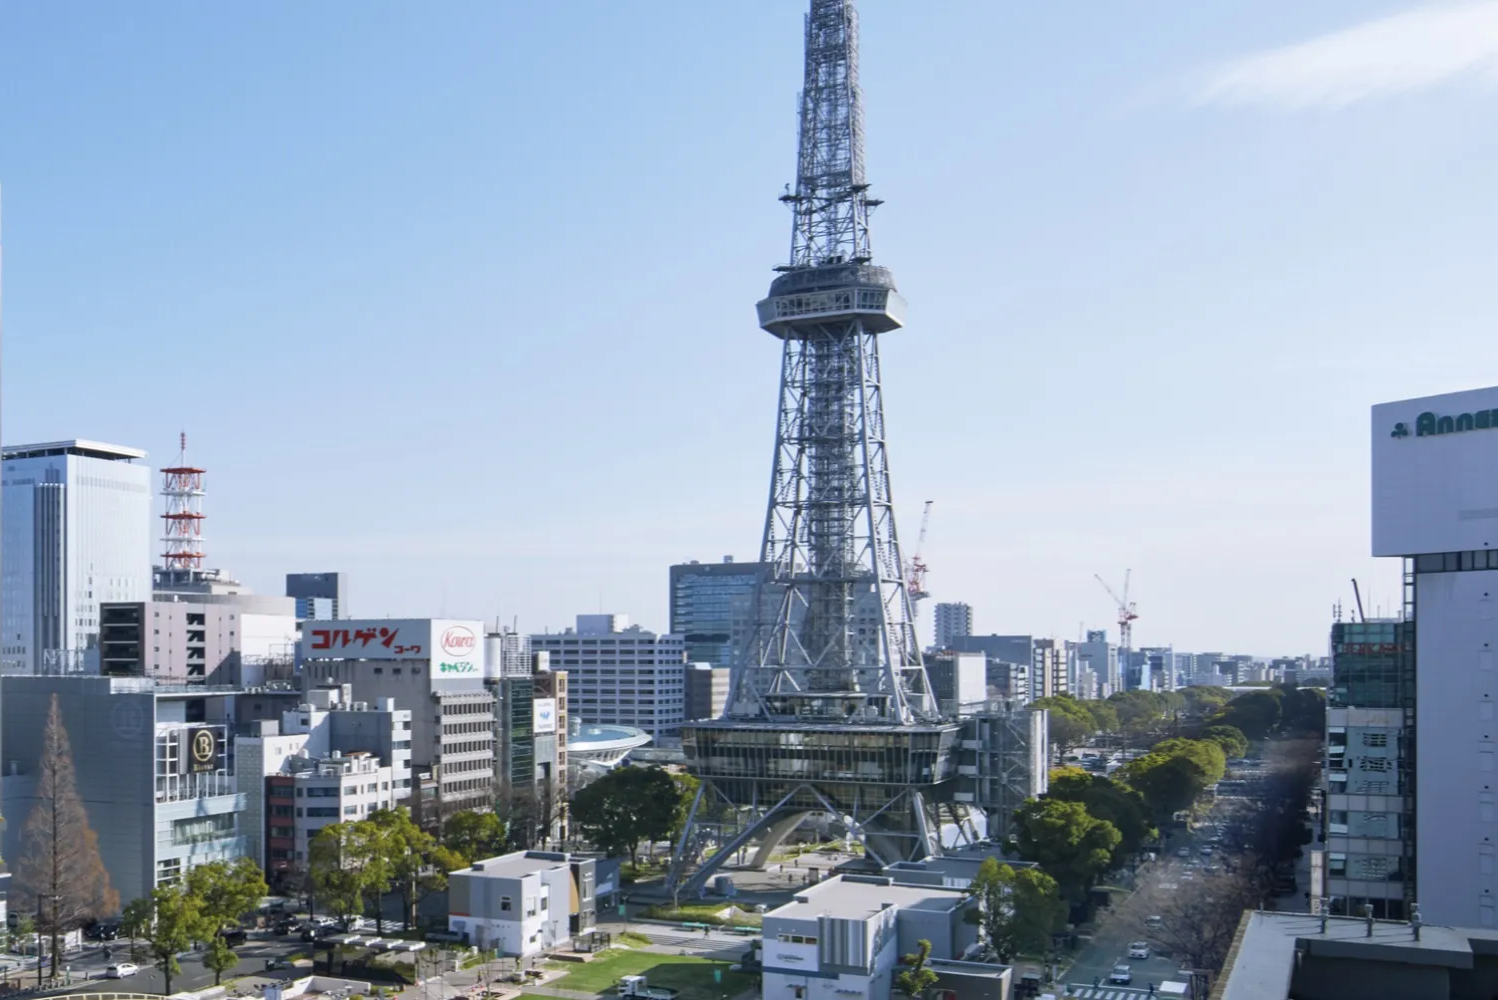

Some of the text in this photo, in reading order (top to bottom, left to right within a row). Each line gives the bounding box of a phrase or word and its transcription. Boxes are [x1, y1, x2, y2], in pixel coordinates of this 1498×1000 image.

[311, 627, 421, 654] コルゲン コーワ
[444, 631, 475, 648] Kowa
